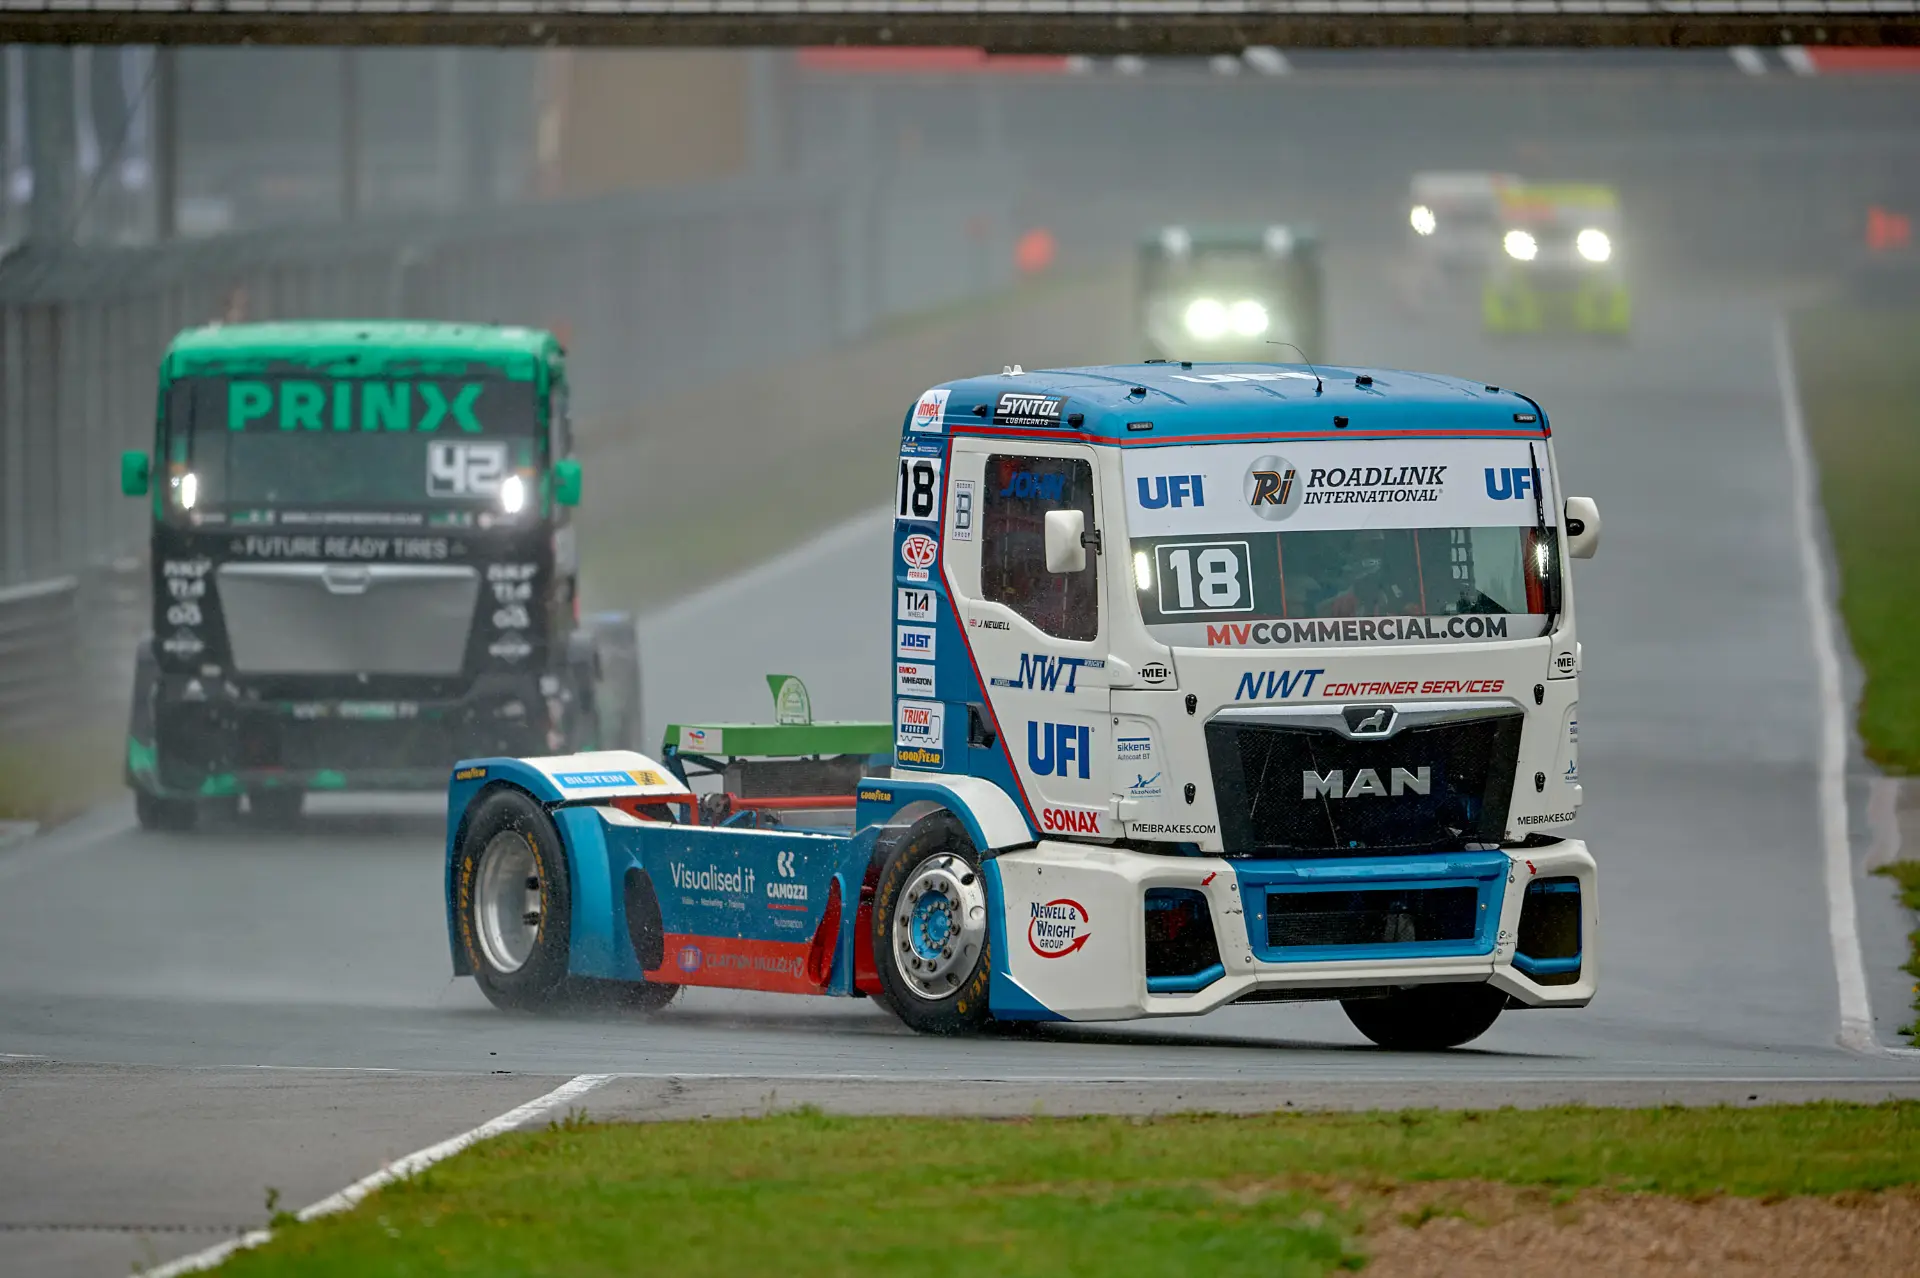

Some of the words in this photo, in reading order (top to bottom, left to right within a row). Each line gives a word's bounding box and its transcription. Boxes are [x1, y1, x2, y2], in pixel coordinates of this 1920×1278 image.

[227, 380, 484, 433] PRINX
[917, 400, 941, 417] imex
[996, 393, 1060, 417] SYNTOL
[1005, 417, 1050, 426] LUBRICANTS
[431, 443, 502, 494] 42
[1307, 466, 1447, 488] ROADLINK
[899, 460, 935, 518] 18
[1000, 471, 1066, 500] JOHN
[1137, 474, 1205, 510] UFI
[1303, 489, 1439, 505] INTERNATIONAL
[246, 535, 320, 559] FUTURE
[325, 536, 387, 559] READY
[393, 537, 448, 559] TIRES
[902, 536, 937, 568] CVS
[908, 571, 928, 579] FERRARI
[1169, 548, 1241, 609] 18
[905, 591, 929, 611] TIA
[978, 619, 982, 628] J
[983, 620, 1010, 631] NEWELL
[1206, 616, 1508, 647] MVCOMMERCIAL.COM
[901, 632, 931, 648] JOST
[899, 666, 917, 674] EMCO
[1557, 657, 1574, 668] MEI
[902, 676, 932, 686] WHEATON
[1018, 653, 1086, 693] NWT
[1141, 668, 1168, 678] MEI
[1235, 669, 1325, 700] NWT
[1322, 681, 1419, 697] CONTAINER
[1420, 679, 1505, 694] SERVICES
[903, 708, 929, 725] TRUCK
[905, 725, 924, 734] FORCE
[898, 747, 941, 763] GOODYEAR
[1028, 720, 1091, 779] UFI
[1117, 743, 1151, 752] sikkens
[563, 773, 627, 785] BILSTEIN
[1302, 766, 1431, 800] MAN
[860, 789, 892, 801] GOODYEAR
[1043, 808, 1101, 834] SONAX
[1132, 823, 1216, 834] MEIBRAKES.COM
[670, 861, 742, 894] Visualised
[744, 867, 755, 894] it
[766, 882, 808, 901] CAMOZZI
[1069, 910, 1076, 920] &
[1039, 938, 1064, 949] GROUP
